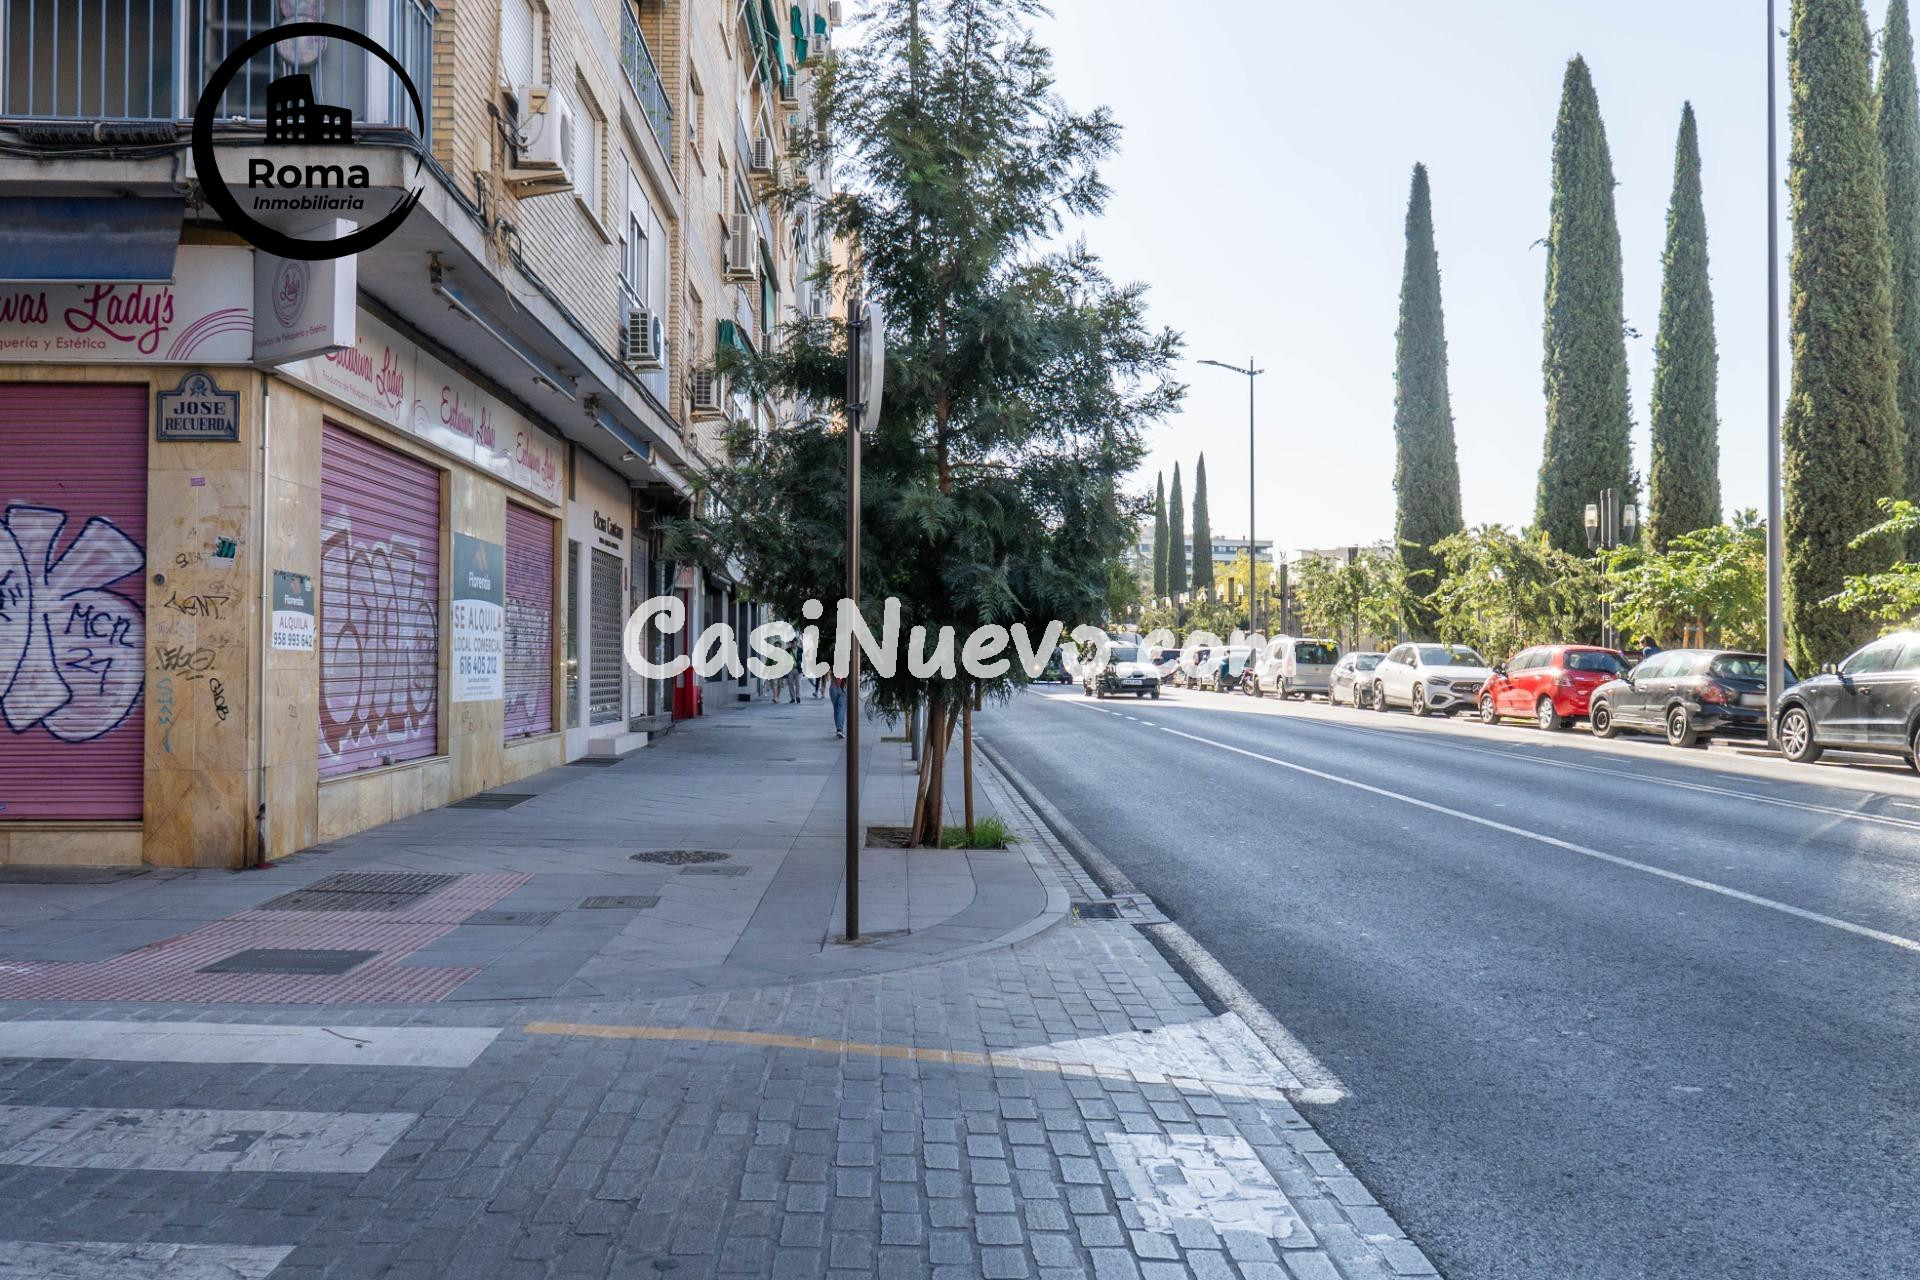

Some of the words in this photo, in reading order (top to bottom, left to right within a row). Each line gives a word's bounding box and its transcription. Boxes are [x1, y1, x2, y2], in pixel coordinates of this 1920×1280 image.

[0, 292, 48, 324] vas
[64, 284, 174, 354] Lady's
[43, 340, 51, 351] y
[56, 337, 107, 349] Estética
[324, 337, 373, 384] xclusivas
[173, 401, 226, 415] JOSE
[165, 418, 234, 433] RECUERDA
[279, 615, 309, 630] ALQUILA
[455, 605, 465, 629] SE
[468, 607, 502, 633] ALQUILA
[273, 631, 287, 646] 958
[287, 633, 301, 647] 993
[301, 634, 313, 648] 642
[454, 636, 472, 653] LOCAL
[473, 637, 502, 653] COMERCIAL
[460, 655, 472, 675] 616
[473, 655, 486, 676] 405
[486, 655, 497, 675] 212
